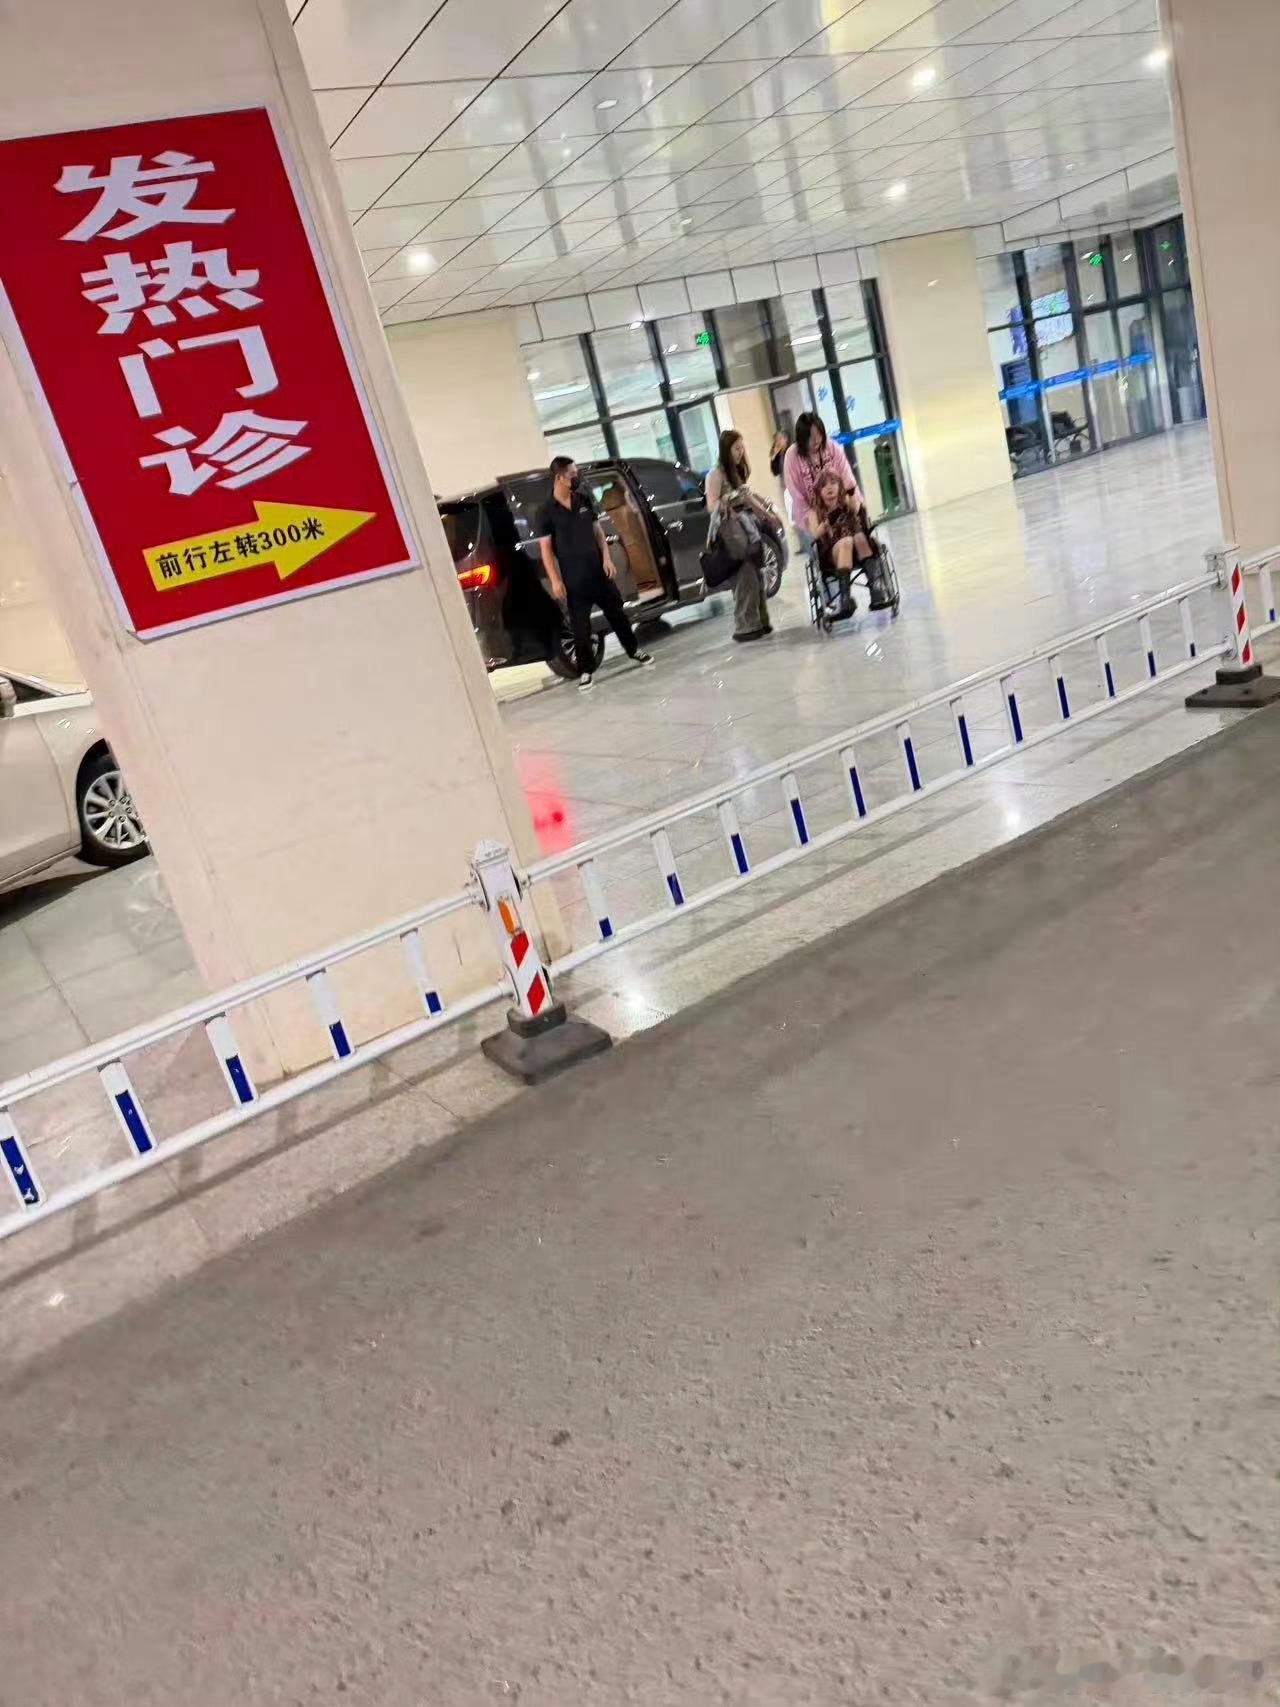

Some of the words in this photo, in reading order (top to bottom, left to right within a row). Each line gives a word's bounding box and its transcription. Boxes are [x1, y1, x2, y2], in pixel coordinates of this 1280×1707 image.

[54, 151, 312, 495] 发热门诊
[156, 517, 325, 579] 前行左转300米
